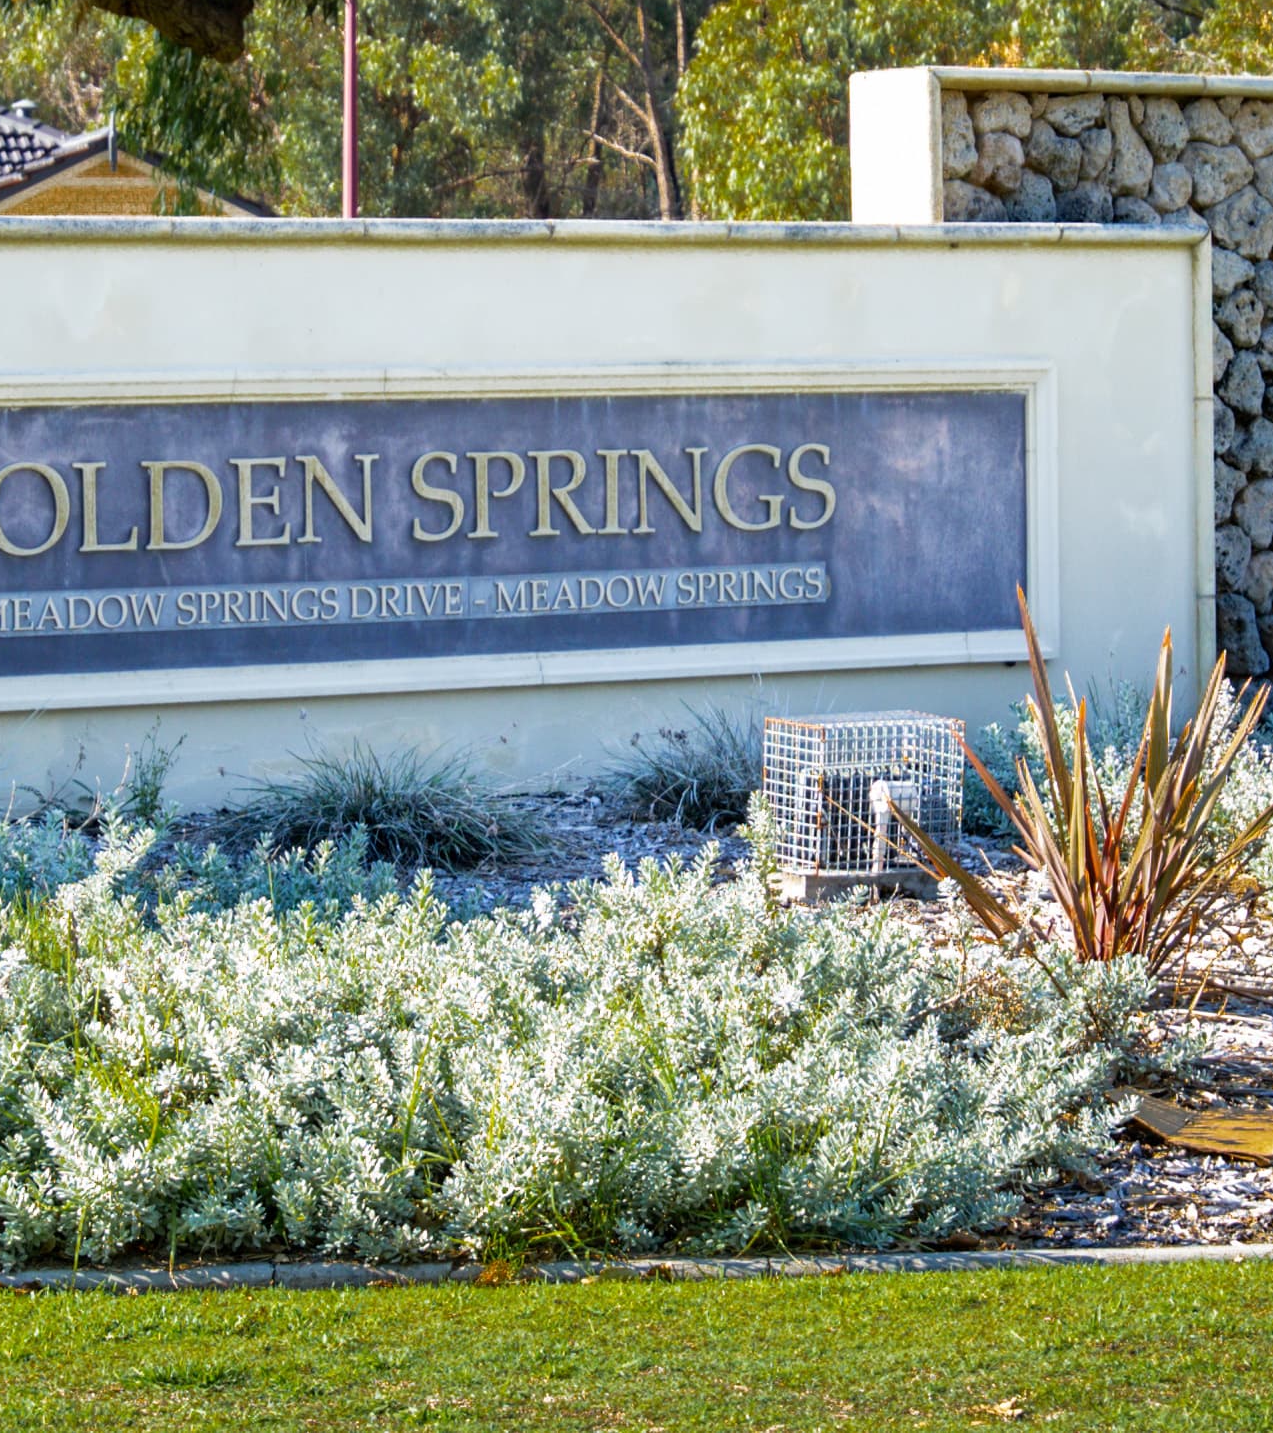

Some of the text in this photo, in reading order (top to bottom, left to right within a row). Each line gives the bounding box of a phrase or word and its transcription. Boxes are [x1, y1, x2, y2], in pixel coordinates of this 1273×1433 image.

[410, 443, 837, 543] SPRINGS
[176, 586, 340, 626] SPRINGS
[349, 582, 463, 619] DRIVE
[494, 574, 668, 613] MEADOW
[676, 567, 824, 605] SPRINGS
